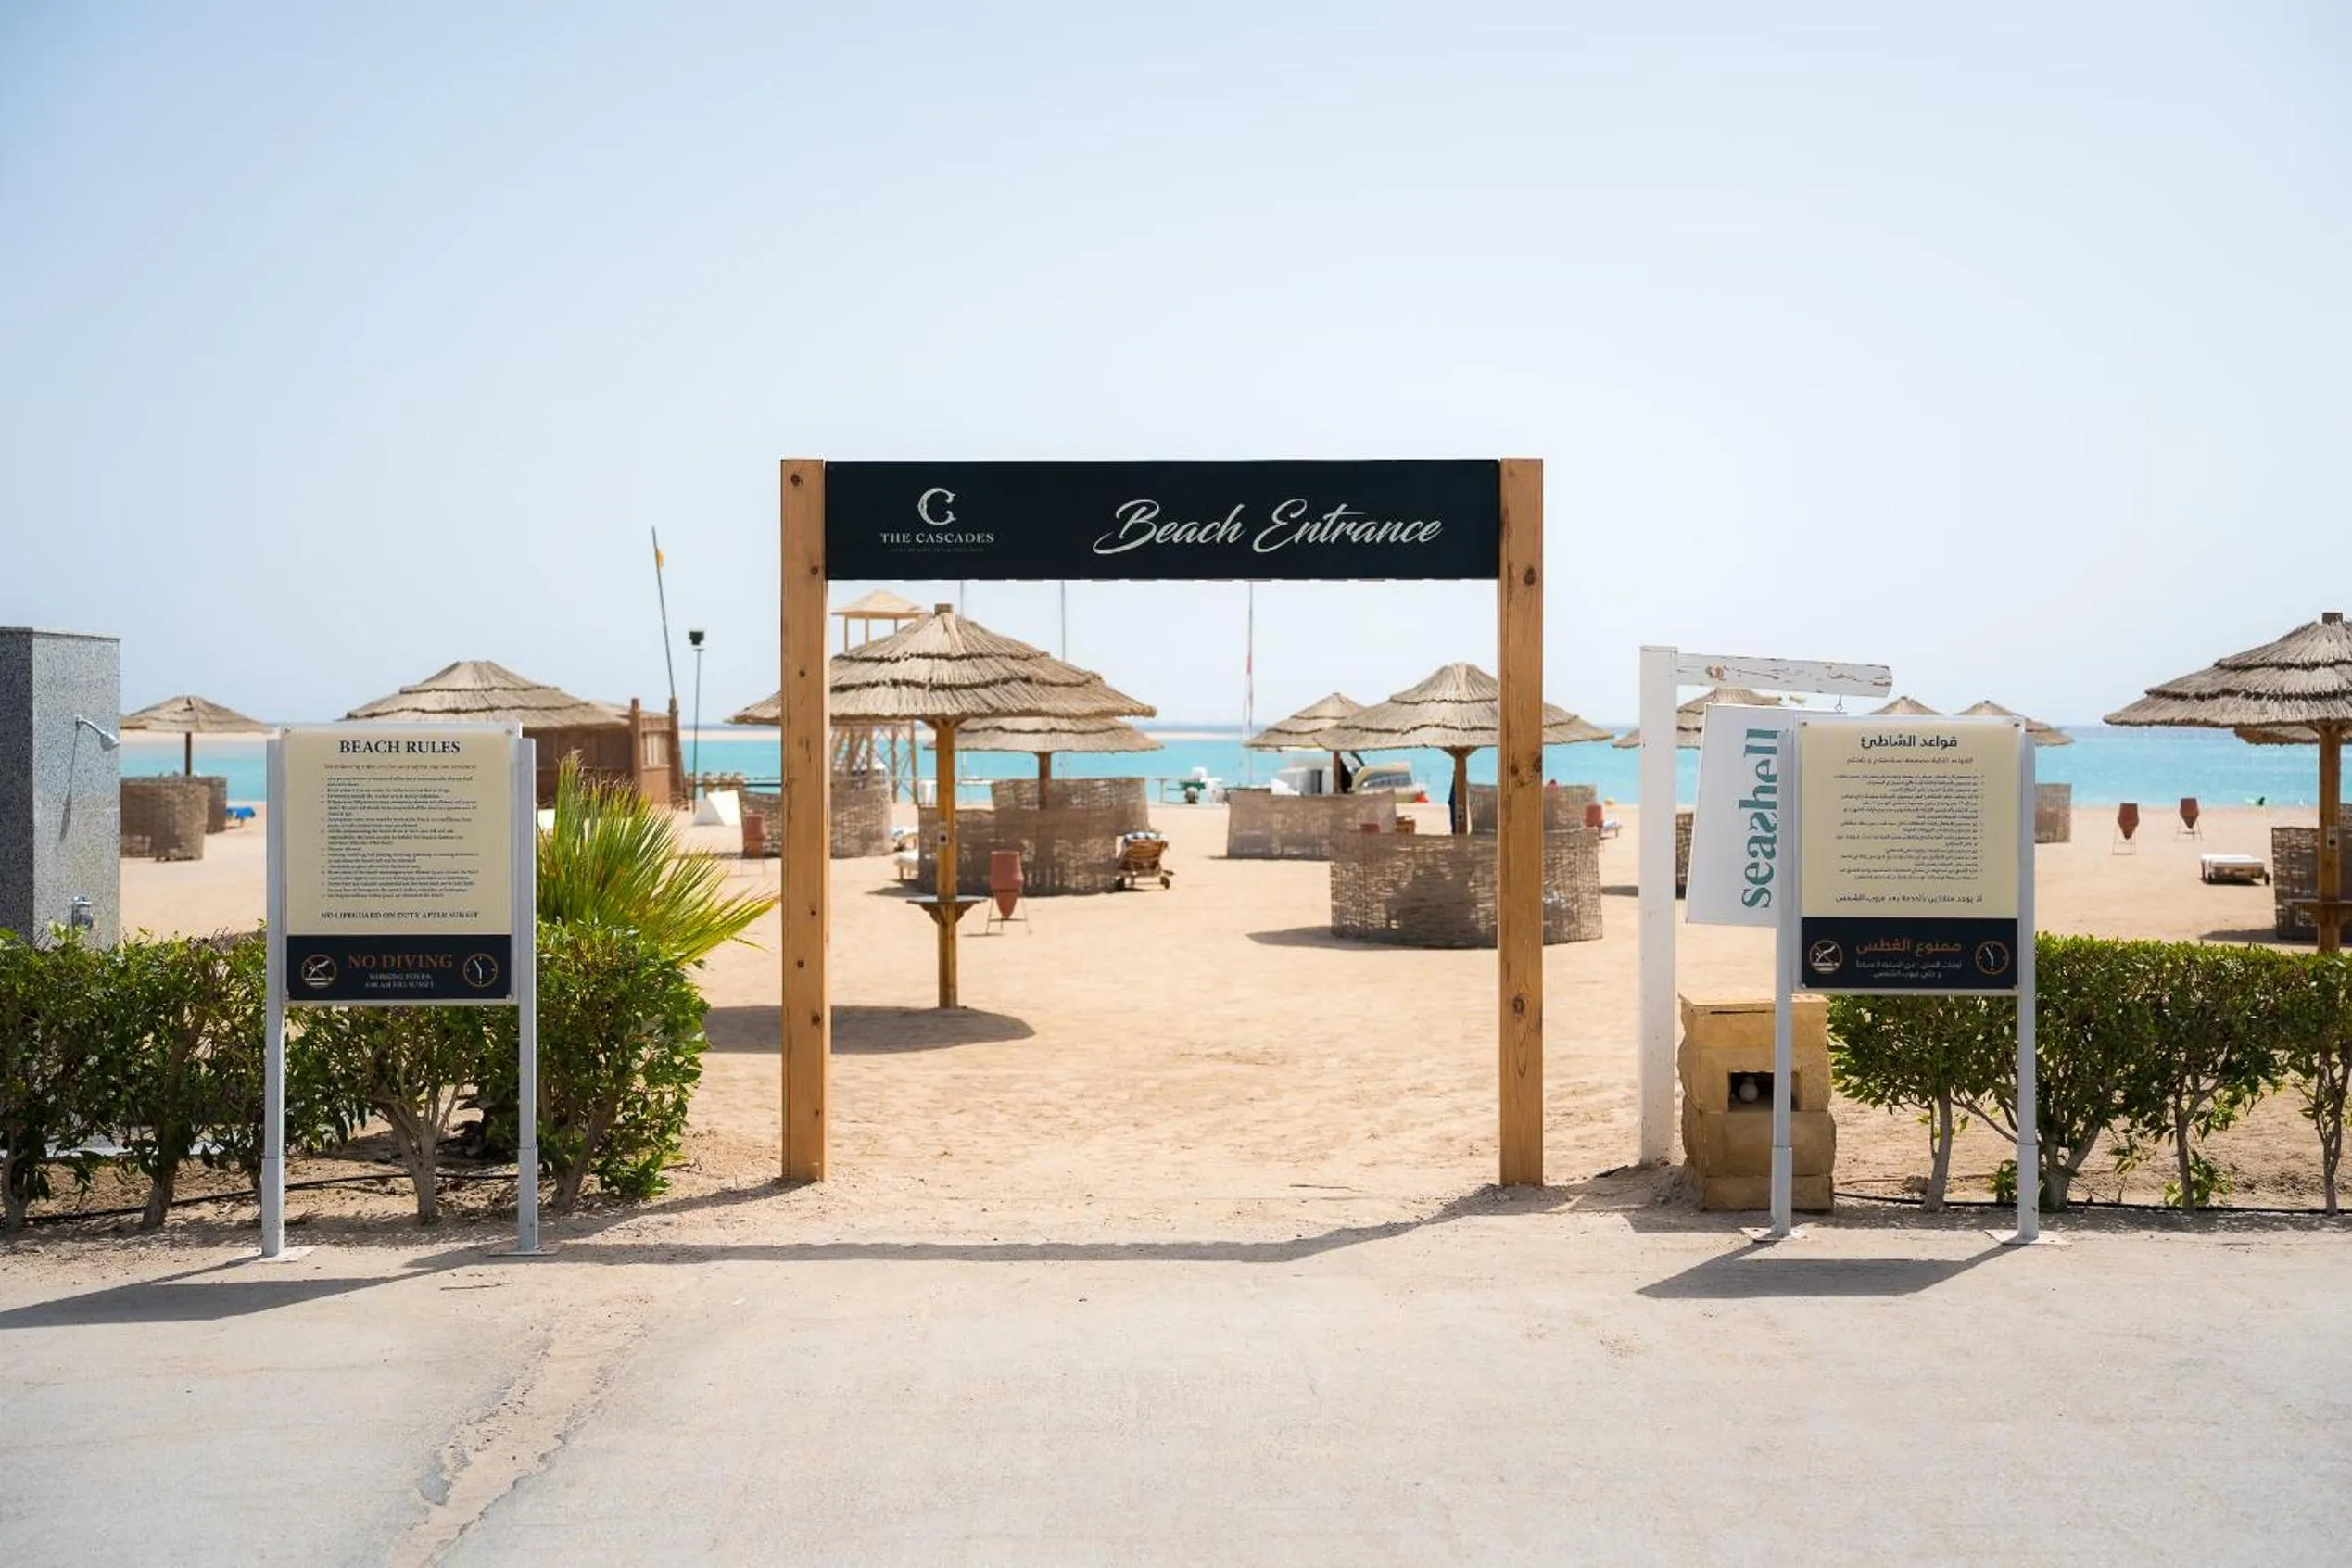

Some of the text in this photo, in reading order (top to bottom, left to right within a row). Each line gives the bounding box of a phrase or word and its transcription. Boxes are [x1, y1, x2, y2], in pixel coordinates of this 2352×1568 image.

[1092, 498, 1444, 555] Beach Entrance
[879, 532, 995, 544] THE CASCADES
[338, 740, 462, 754] BEACH RULES
[1860, 733, 1958, 750] قواعد الشاطئ
[1738, 727, 1780, 909] seashell
[321, 911, 335, 919] NO
[335, 911, 382, 919] LIFEGUARD
[382, 911, 396, 919] ON
[397, 911, 420, 919] DUTY
[422, 911, 448, 919] AFTER
[1854, 937, 1963, 956] ممنوع الغطس
[347, 954, 453, 969] NO DIVING
